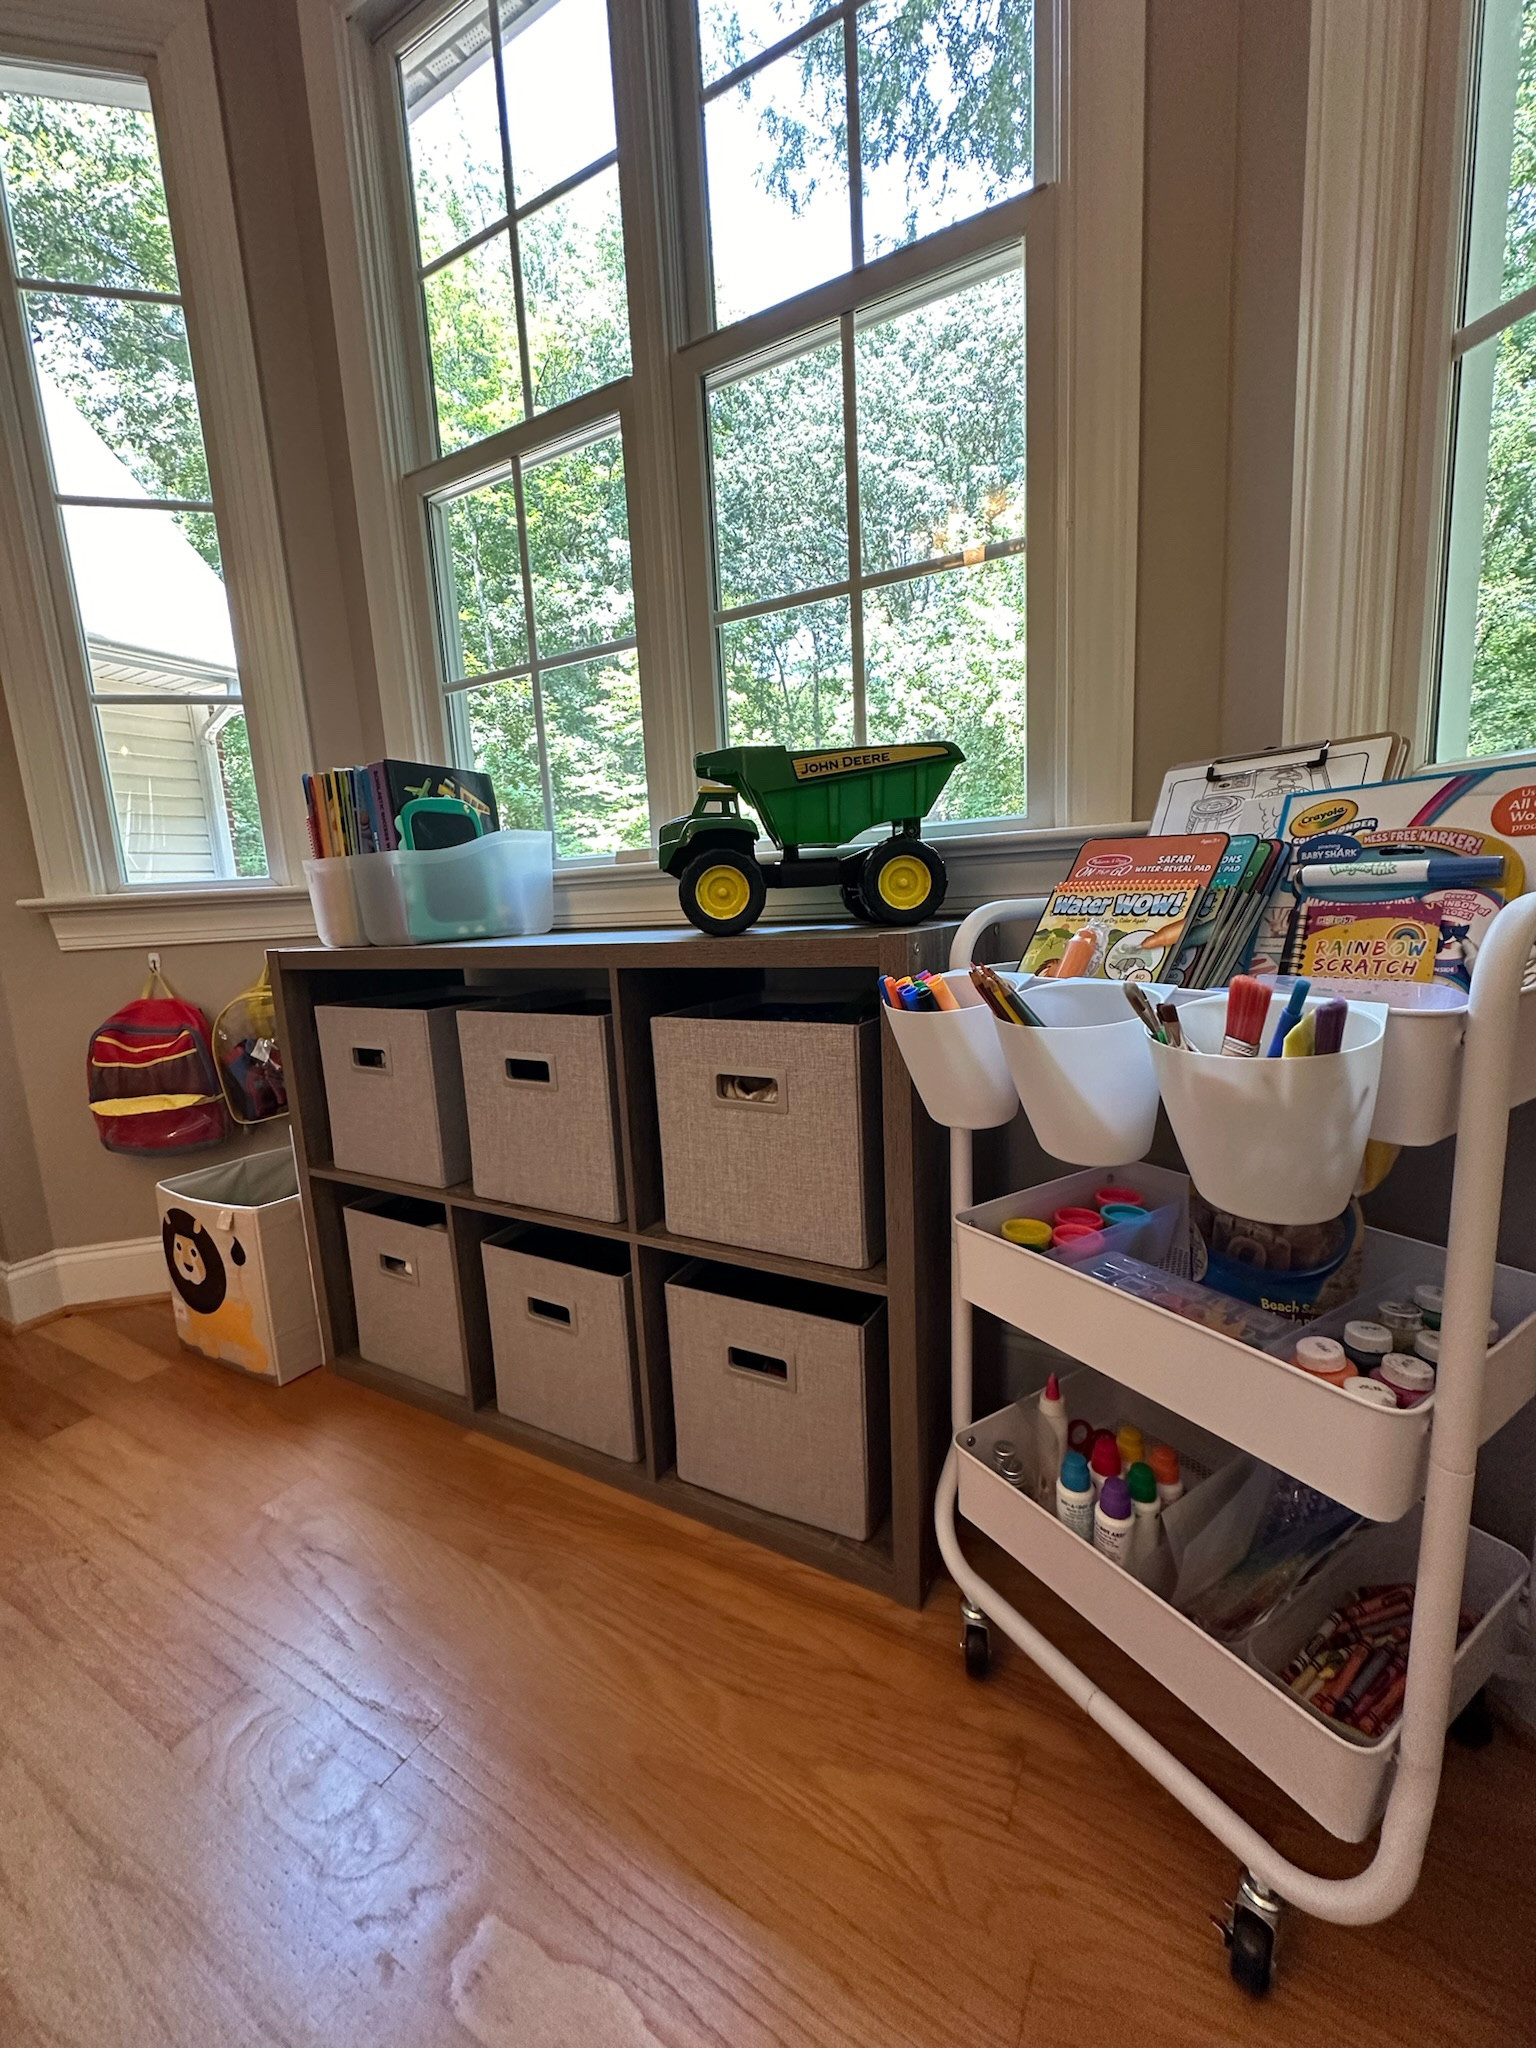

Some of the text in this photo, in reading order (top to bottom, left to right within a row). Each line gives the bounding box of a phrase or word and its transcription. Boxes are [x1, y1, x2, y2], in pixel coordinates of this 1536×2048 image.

[801, 751, 890, 775] JOHN DEERE
[1508, 798, 1531, 811] All
[1301, 806, 1347, 824] Crayola
[1363, 829, 1484, 855] MESS FREE MARKER!
[1157, 855, 1196, 864] SAFARI
[1301, 846, 1358, 860] BABY SHARK
[1075, 866, 1097, 878] ON
[1110, 864, 1133, 877] GO
[1135, 865, 1192, 873] WATER-REVEAL
[1194, 864, 1212, 872] PAD
[1223, 865, 1241, 873] PAD
[1444, 892, 1477, 900] Reveal
[1053, 891, 1188, 917] Water WOW!
[1478, 907, 1492, 918] of
[1314, 939, 1428, 957] RAINBOW
[1312, 957, 1420, 976] SCRATCH
[1260, 1296, 1300, 1313] Beach
